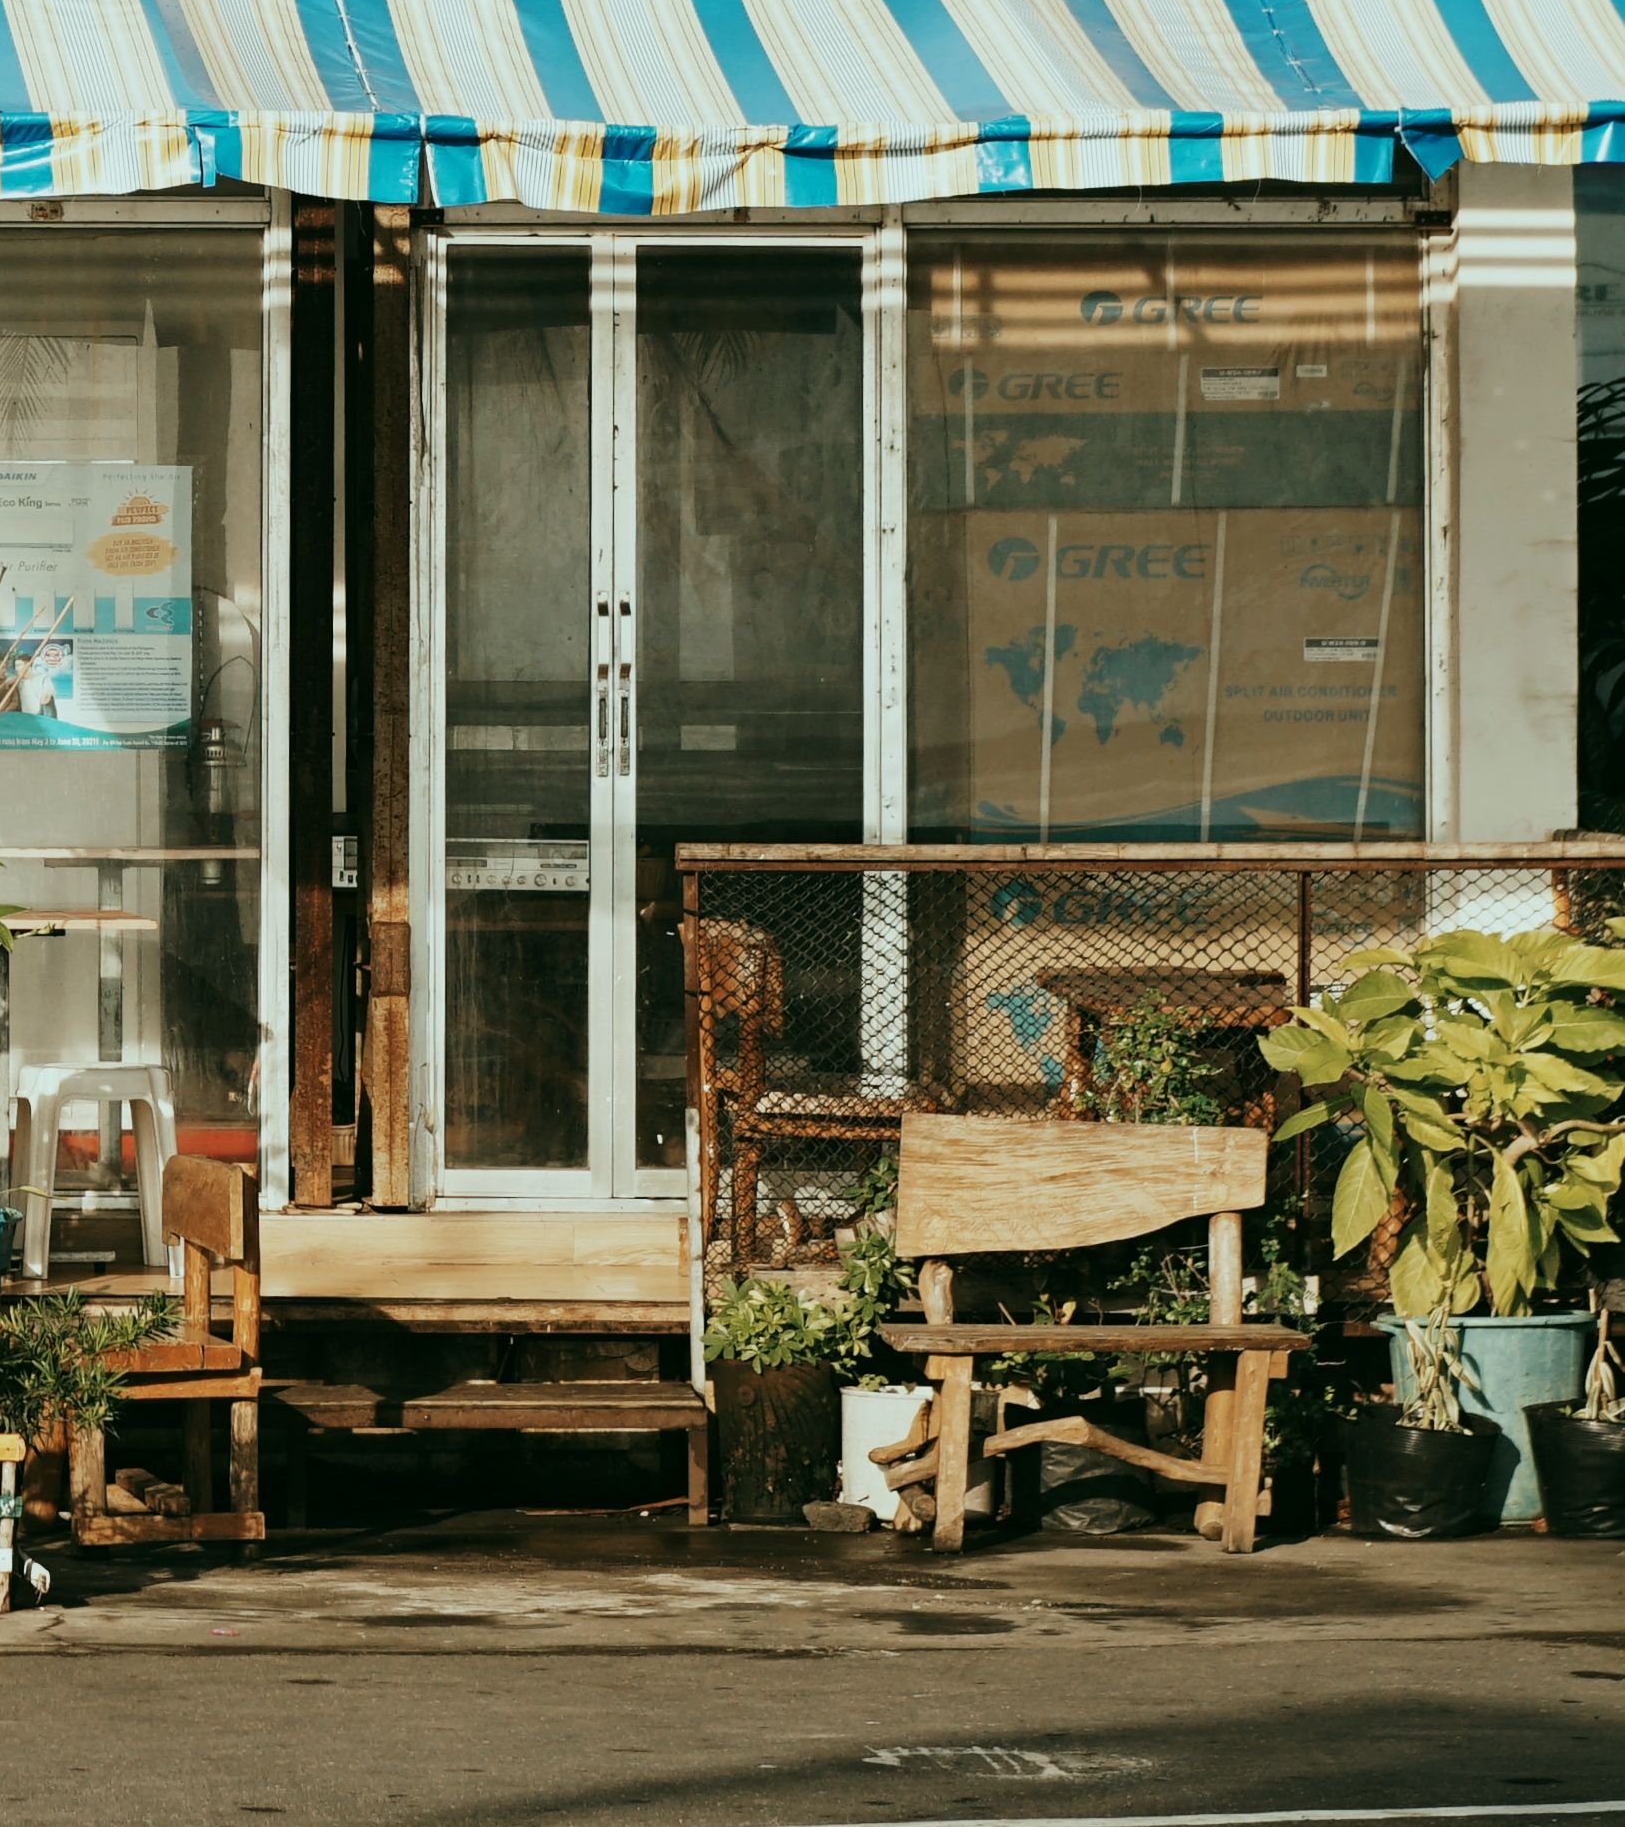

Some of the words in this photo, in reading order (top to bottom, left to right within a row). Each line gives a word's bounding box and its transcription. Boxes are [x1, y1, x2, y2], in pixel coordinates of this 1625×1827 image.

[1132, 294, 1264, 325] GREE
[998, 372, 1123, 402] GREE
[18, 495, 43, 510] King
[17, 560, 59, 573] Purifier
[1053, 544, 1212, 581] GREE
[1224, 684, 1265, 698] SPLIT
[1268, 684, 1292, 698] AIR
[1262, 709, 1335, 723] OUTDOOR
[1337, 709, 1371, 723] UNIT
